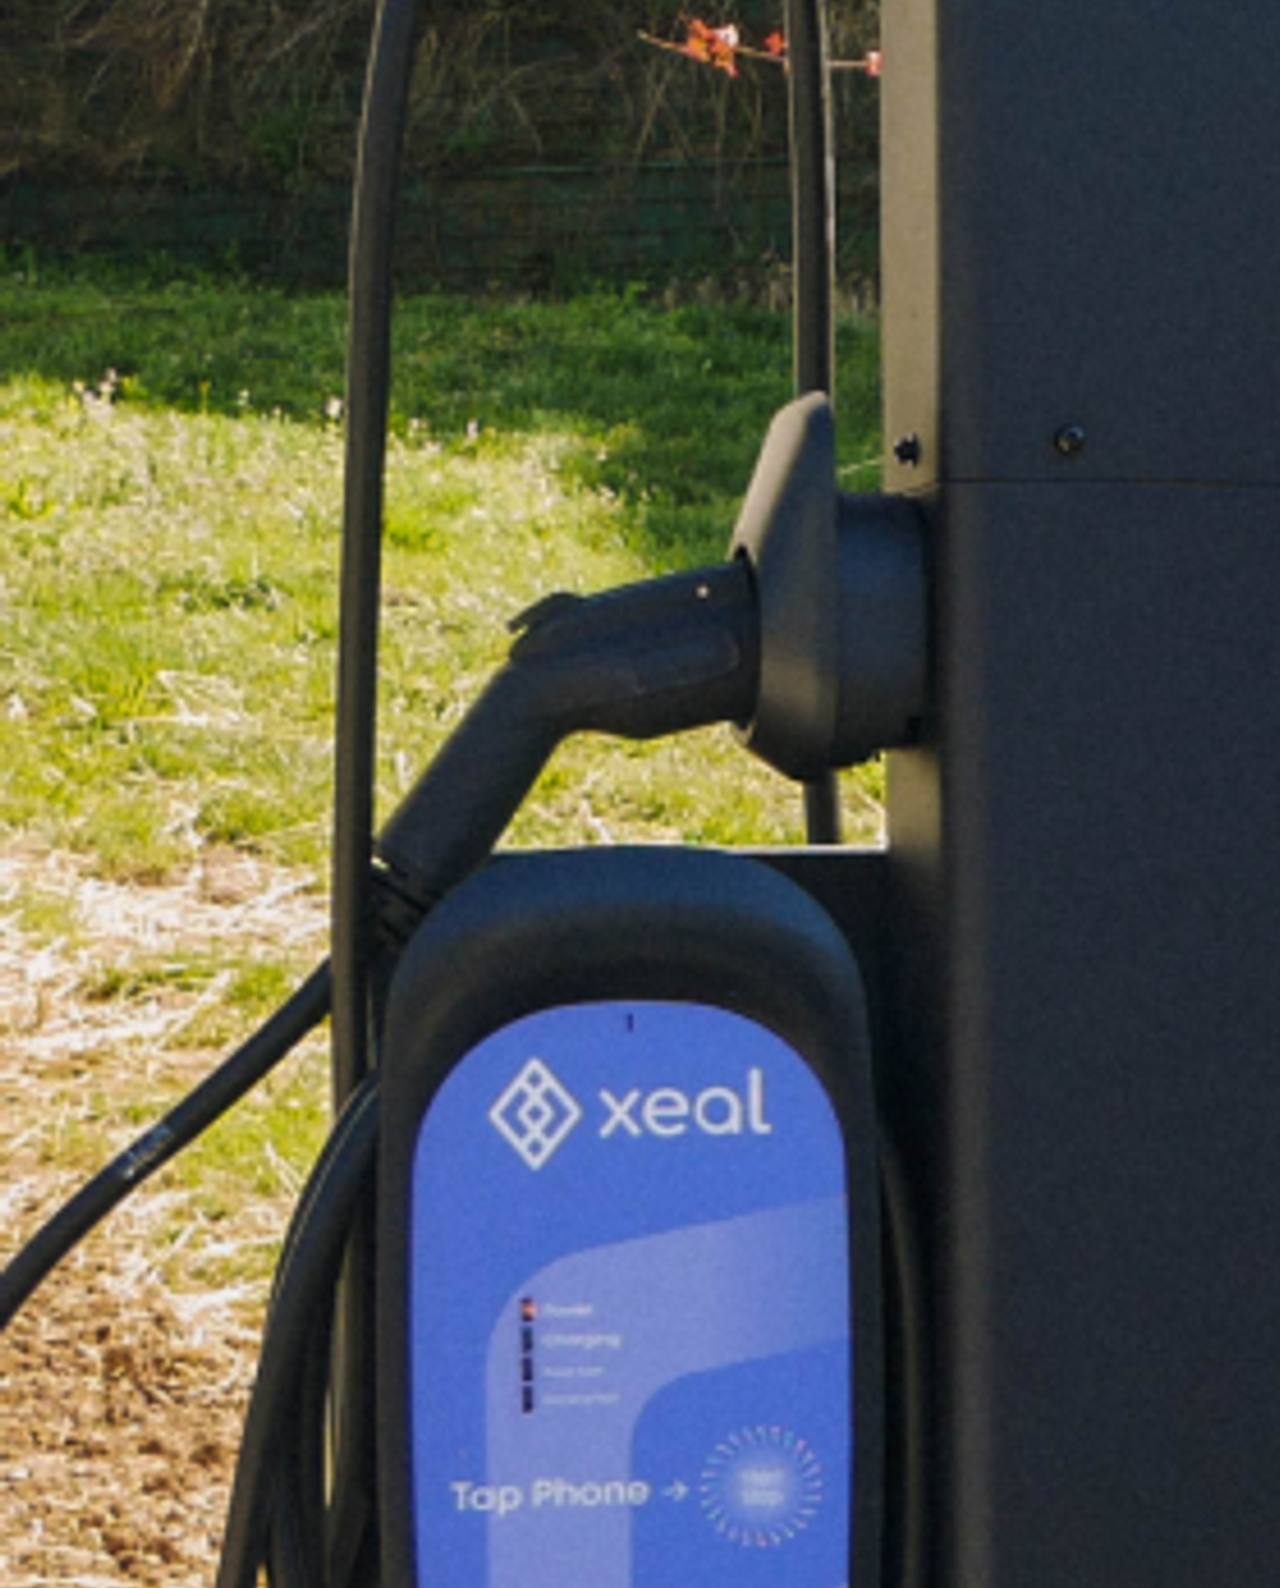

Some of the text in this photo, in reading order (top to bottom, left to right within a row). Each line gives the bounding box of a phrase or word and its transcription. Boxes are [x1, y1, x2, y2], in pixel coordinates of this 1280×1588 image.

[600, 1067, 771, 1138] xeal
[450, 1477, 651, 1516] Tap Phone
